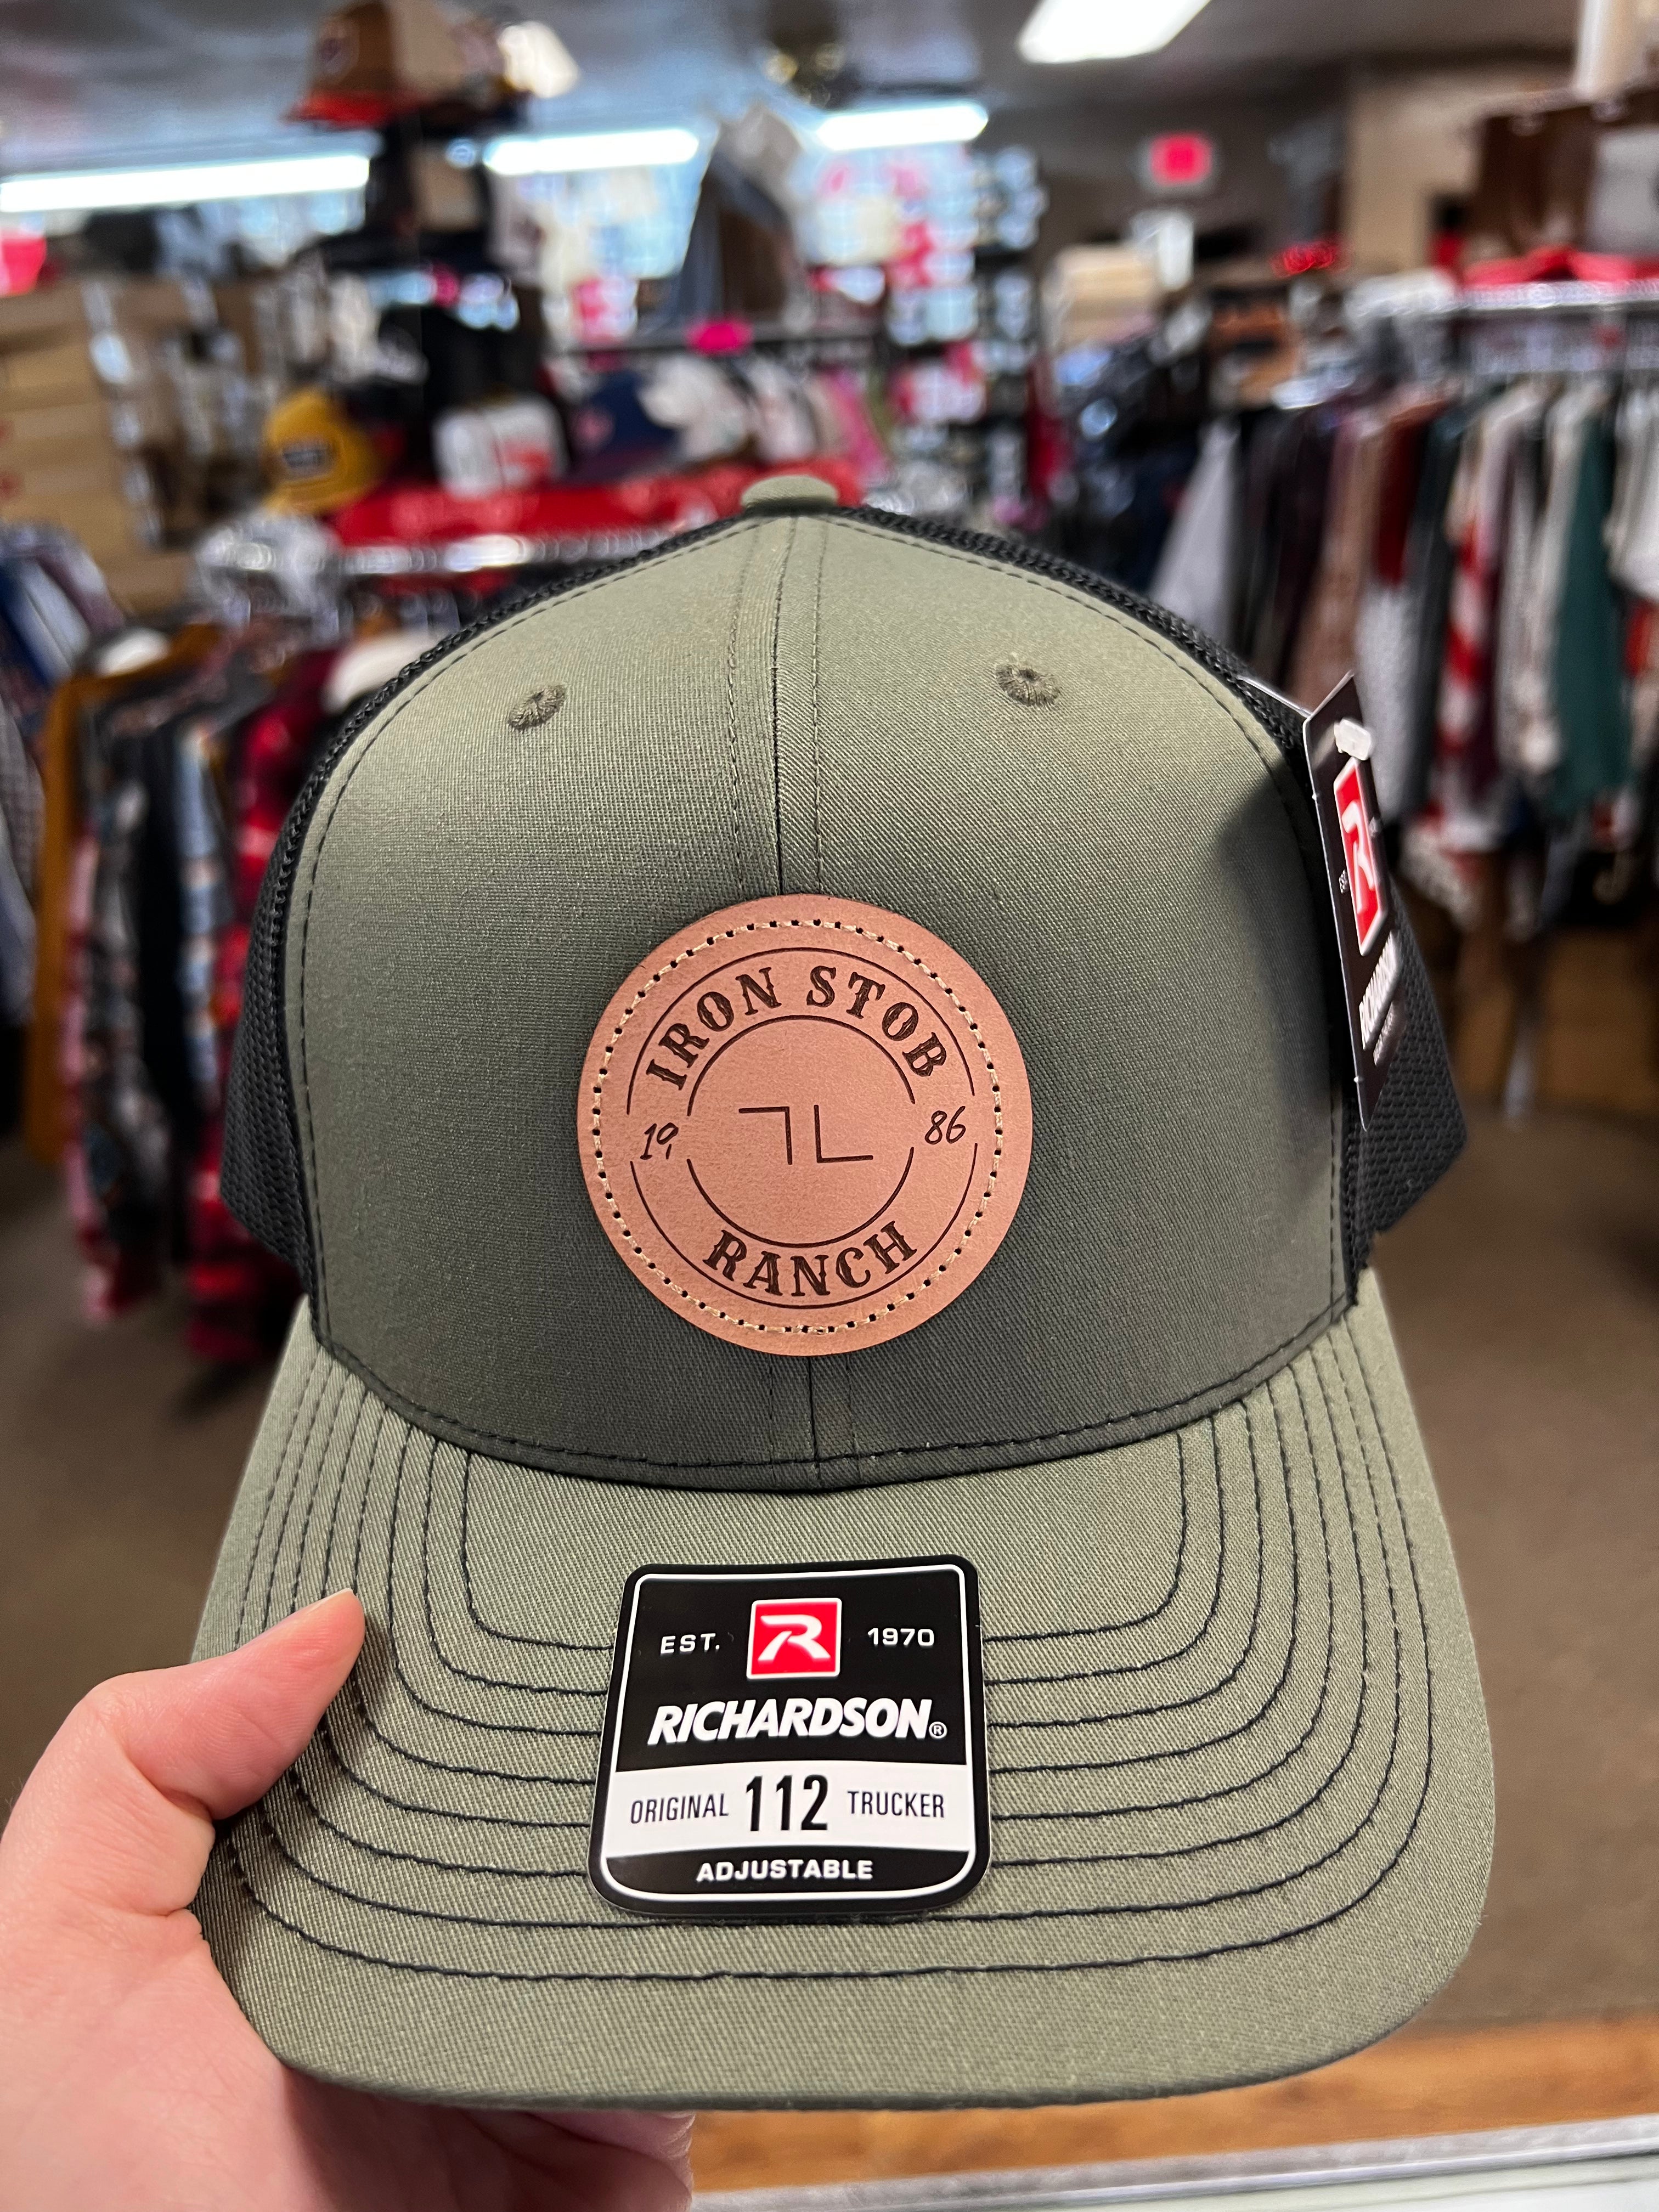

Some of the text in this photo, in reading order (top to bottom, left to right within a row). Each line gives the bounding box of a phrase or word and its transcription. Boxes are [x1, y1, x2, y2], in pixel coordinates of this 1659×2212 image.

[647, 965, 947, 1090] IRON STOB
[640, 1105, 966, 1160] 19 86
[703, 1221, 917, 1296] RANCH
[660, 1627, 935, 1655] EST. 1970
[630, 1774, 945, 1832] ORIGINAL 112 TRUCKER
[696, 1859, 873, 1882] ADJUSTABLE
